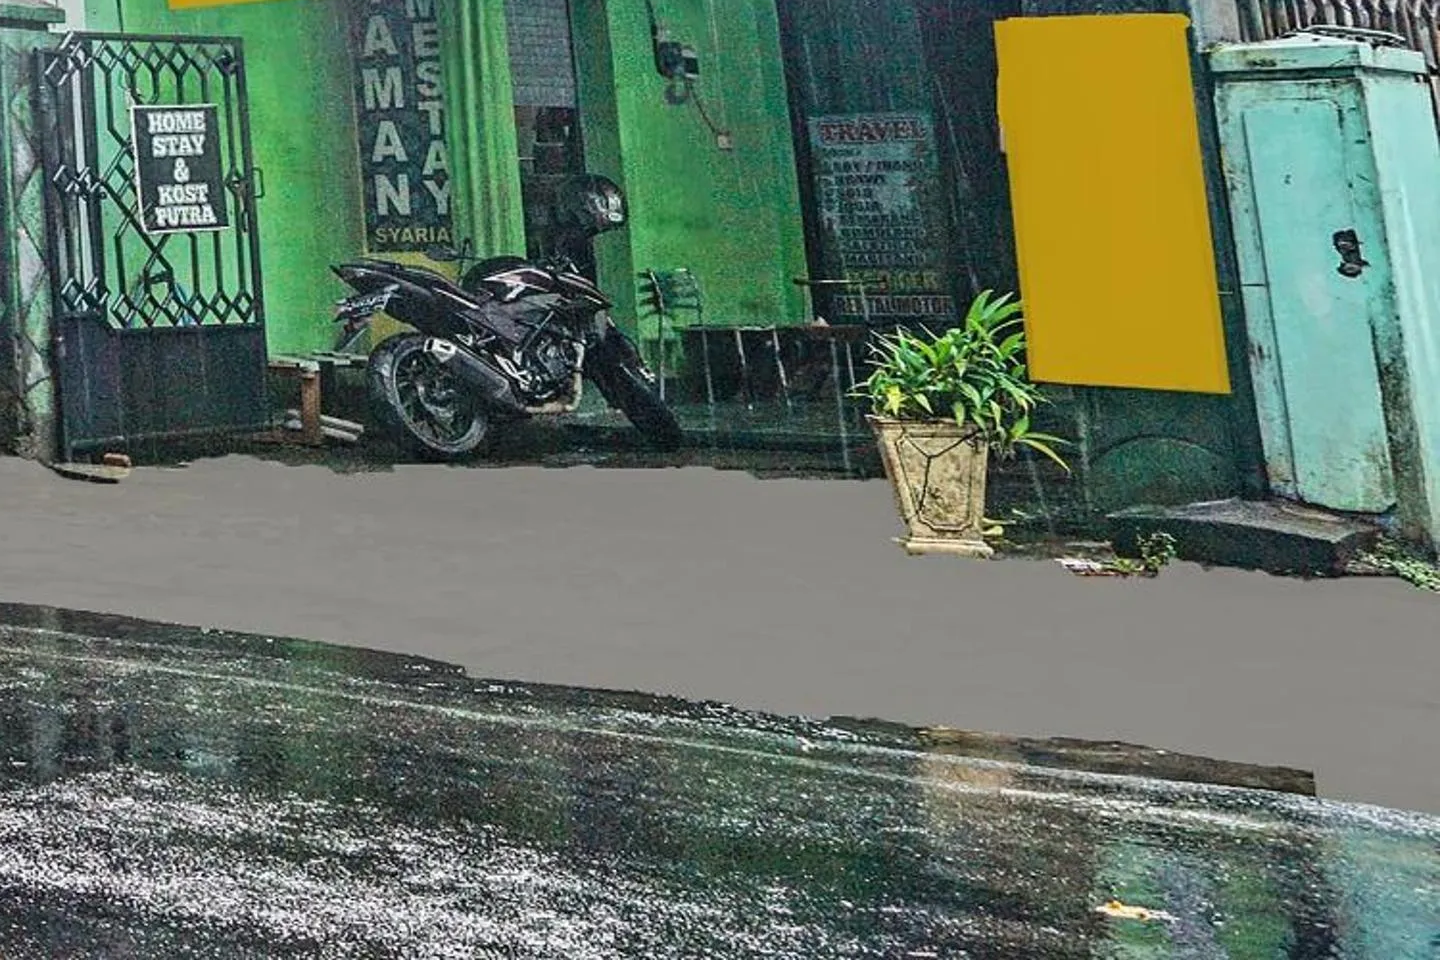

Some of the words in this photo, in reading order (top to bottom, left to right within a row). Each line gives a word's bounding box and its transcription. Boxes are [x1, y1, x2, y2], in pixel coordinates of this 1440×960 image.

[147, 111, 206, 134] HOME
[820, 117, 926, 144] TRAVEL
[152, 133, 205, 158] STAY
[173, 156, 190, 182] &
[157, 182, 208, 206] KOST
[155, 204, 217, 227] PUTRA
